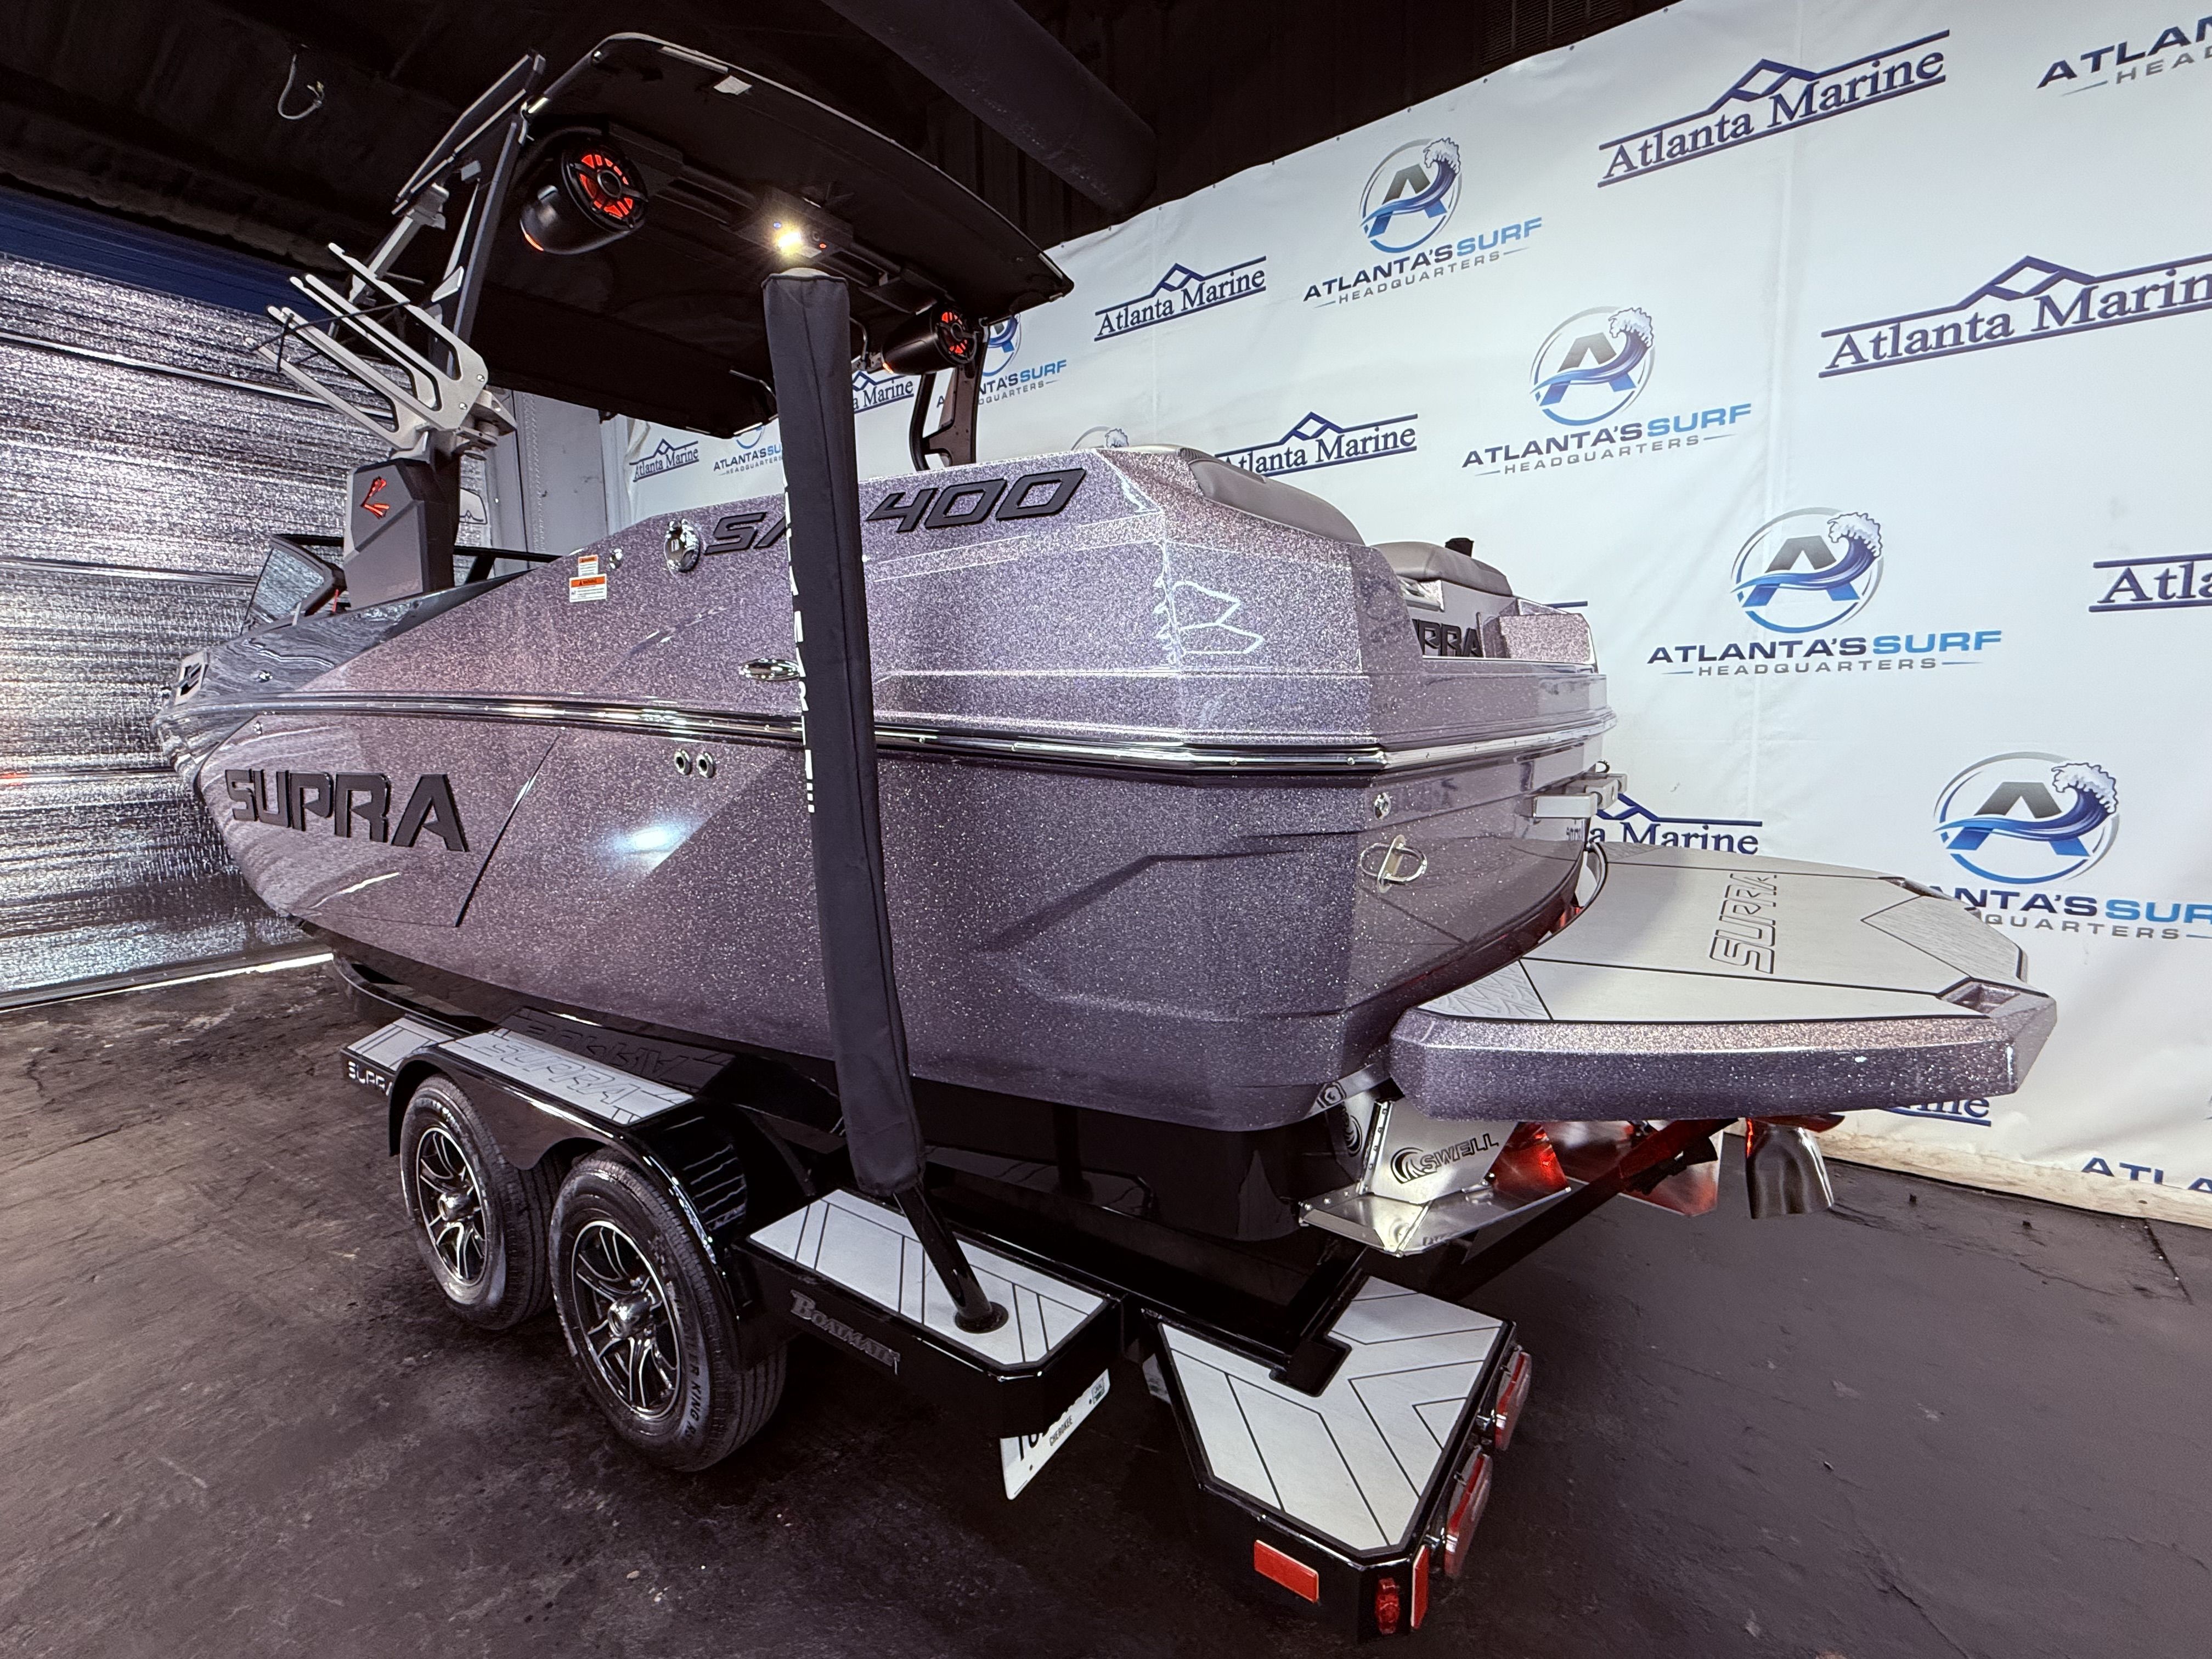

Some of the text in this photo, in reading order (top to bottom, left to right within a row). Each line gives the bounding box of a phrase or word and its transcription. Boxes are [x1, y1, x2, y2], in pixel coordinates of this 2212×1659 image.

[1602, 48, 1944, 180] Atlanta Marine
[1304, 217, 1542, 302] ATLANTA'S SURF
[1339, 250, 1500, 304] HEADQUARTERS
[1098, 265, 1266, 336] Atlanta Marine
[1825, 308, 2015, 370] Atlanta
[864, 379, 914, 404] Marine
[1020, 359, 1067, 383] SURF
[1224, 427, 1416, 474] tlanta Marine
[1461, 403, 1752, 468] ATLANTA'S SURF
[1504, 435, 1700, 475] HEADQUARTERS
[634, 448, 698, 479] Atlanta Marine
[713, 449, 767, 472] ATLANTA'S
[865, 467, 1087, 533] 400
[1646, 630, 2002, 664] ATLANTA'S SURF
[1699, 658, 1937, 676] HEADQUARTERS
[224, 768, 470, 852] SUPRA
[1620, 822, 1759, 855] Marine
[490, 1041, 641, 1105] SUPRA
[1420, 1133, 1499, 1173] SWELL
[690, 1380, 702, 1422] KING
